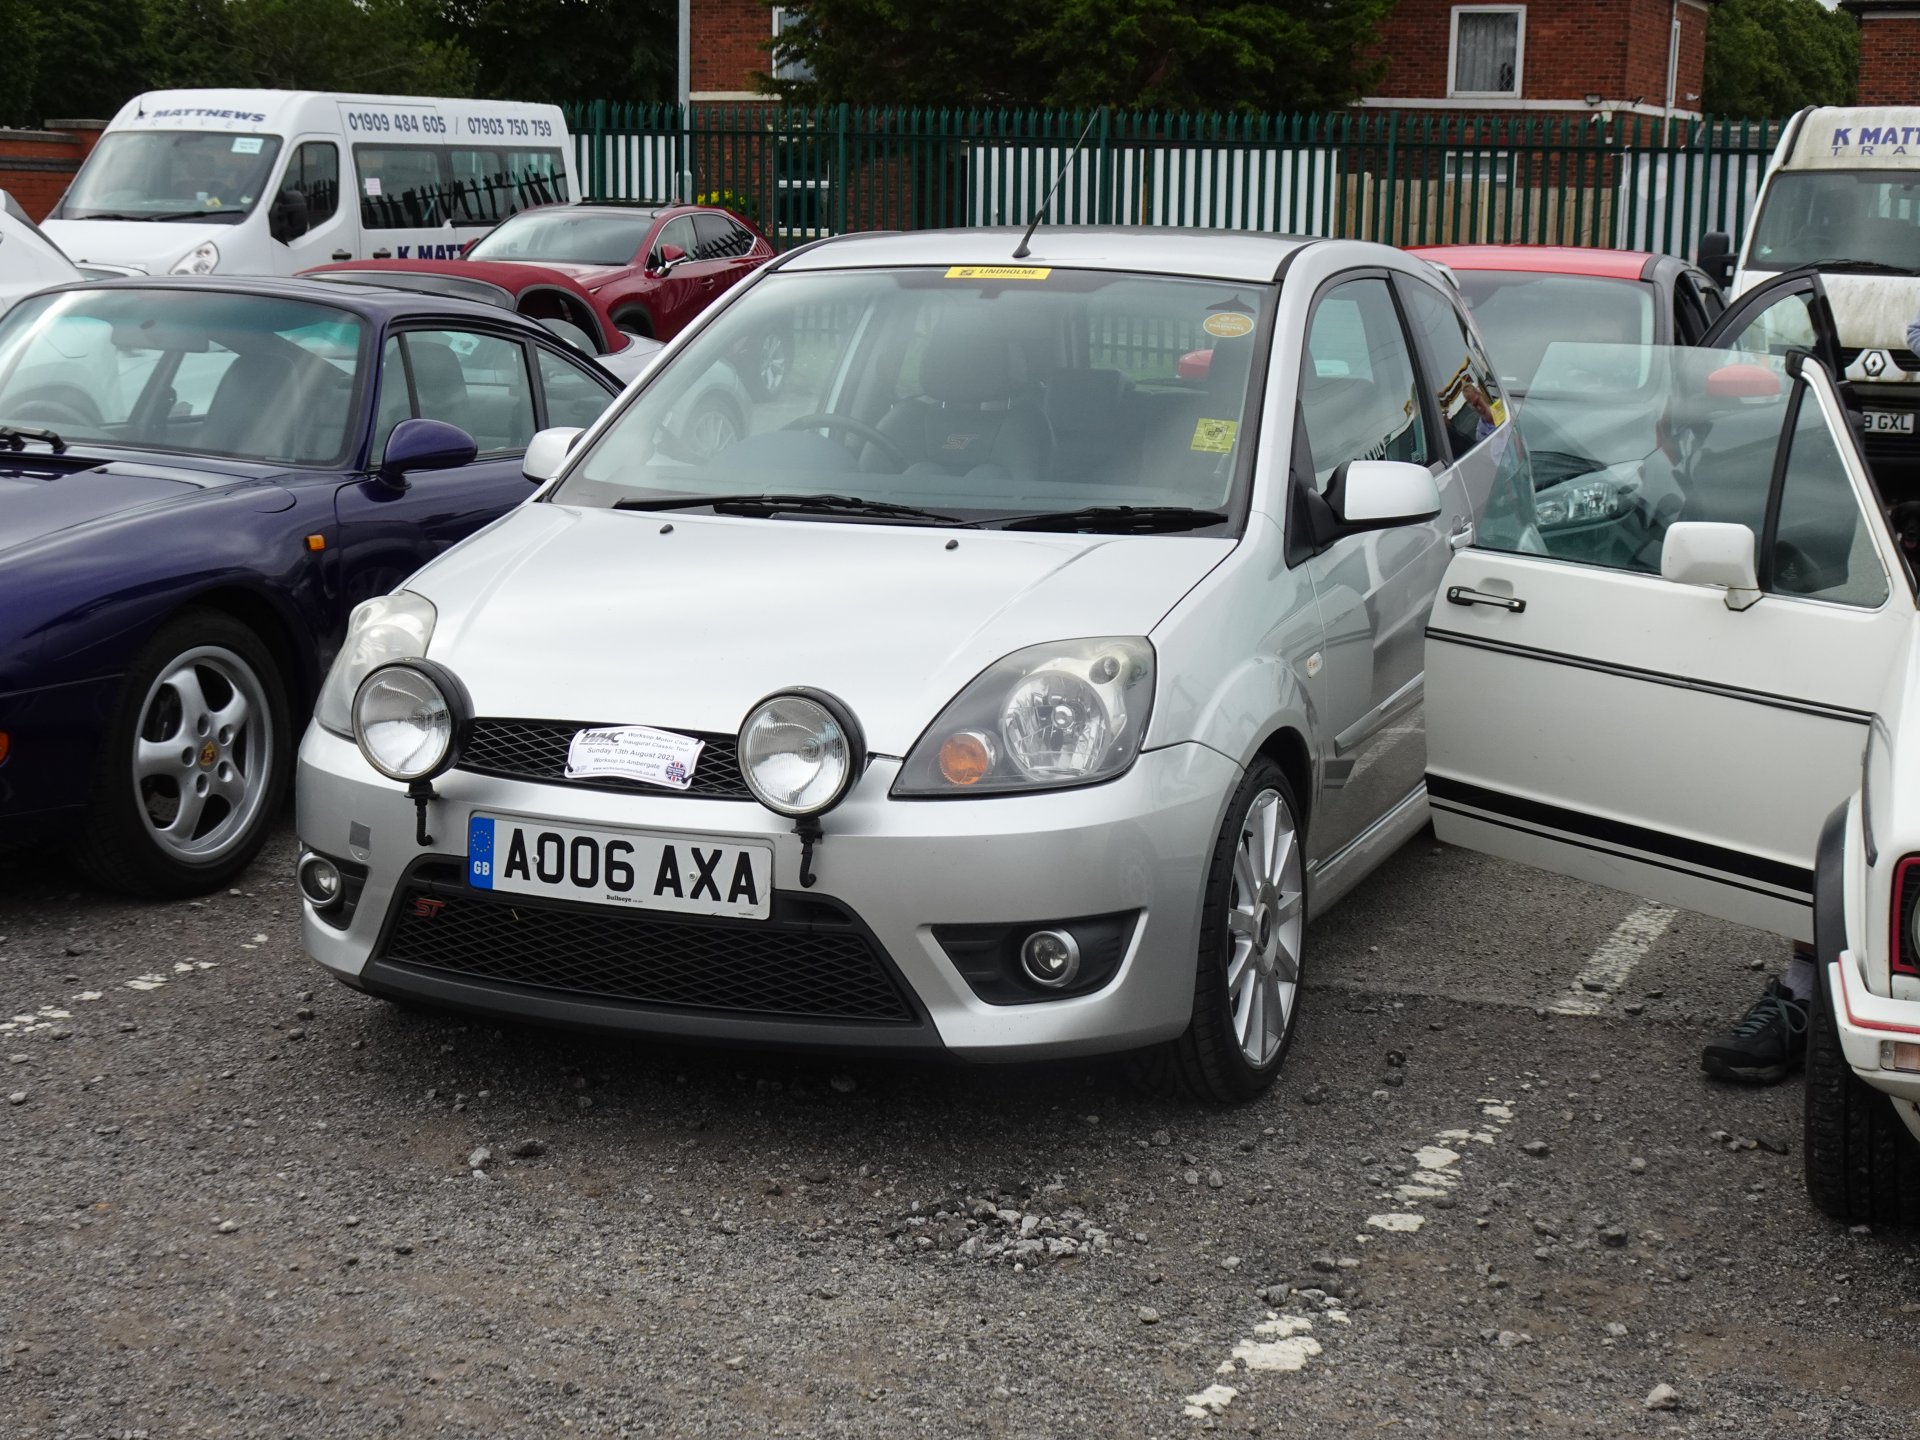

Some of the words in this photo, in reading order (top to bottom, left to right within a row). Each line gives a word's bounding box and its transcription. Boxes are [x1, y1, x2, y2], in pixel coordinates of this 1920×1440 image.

[153, 109, 266, 122] MATTHEWS
[349, 112, 389, 132] 01909
[394, 114, 419, 133] 484
[423, 115, 446, 134] 605
[467, 117, 504, 135] 07903
[507, 118, 529, 136] 750
[531, 120, 552, 137] 759
[1832, 127, 1852, 145] K
[397, 246, 410, 259] K
[1878, 415, 1910, 430] GXL
[628, 732, 654, 740] Worksop
[630, 749, 656, 759] August
[657, 753, 675, 761] 2023
[473, 860, 490, 876] GB
[653, 844, 759, 905] AXA
[606, 894, 632, 903] Bullseye
[415, 898, 447, 918] ST
